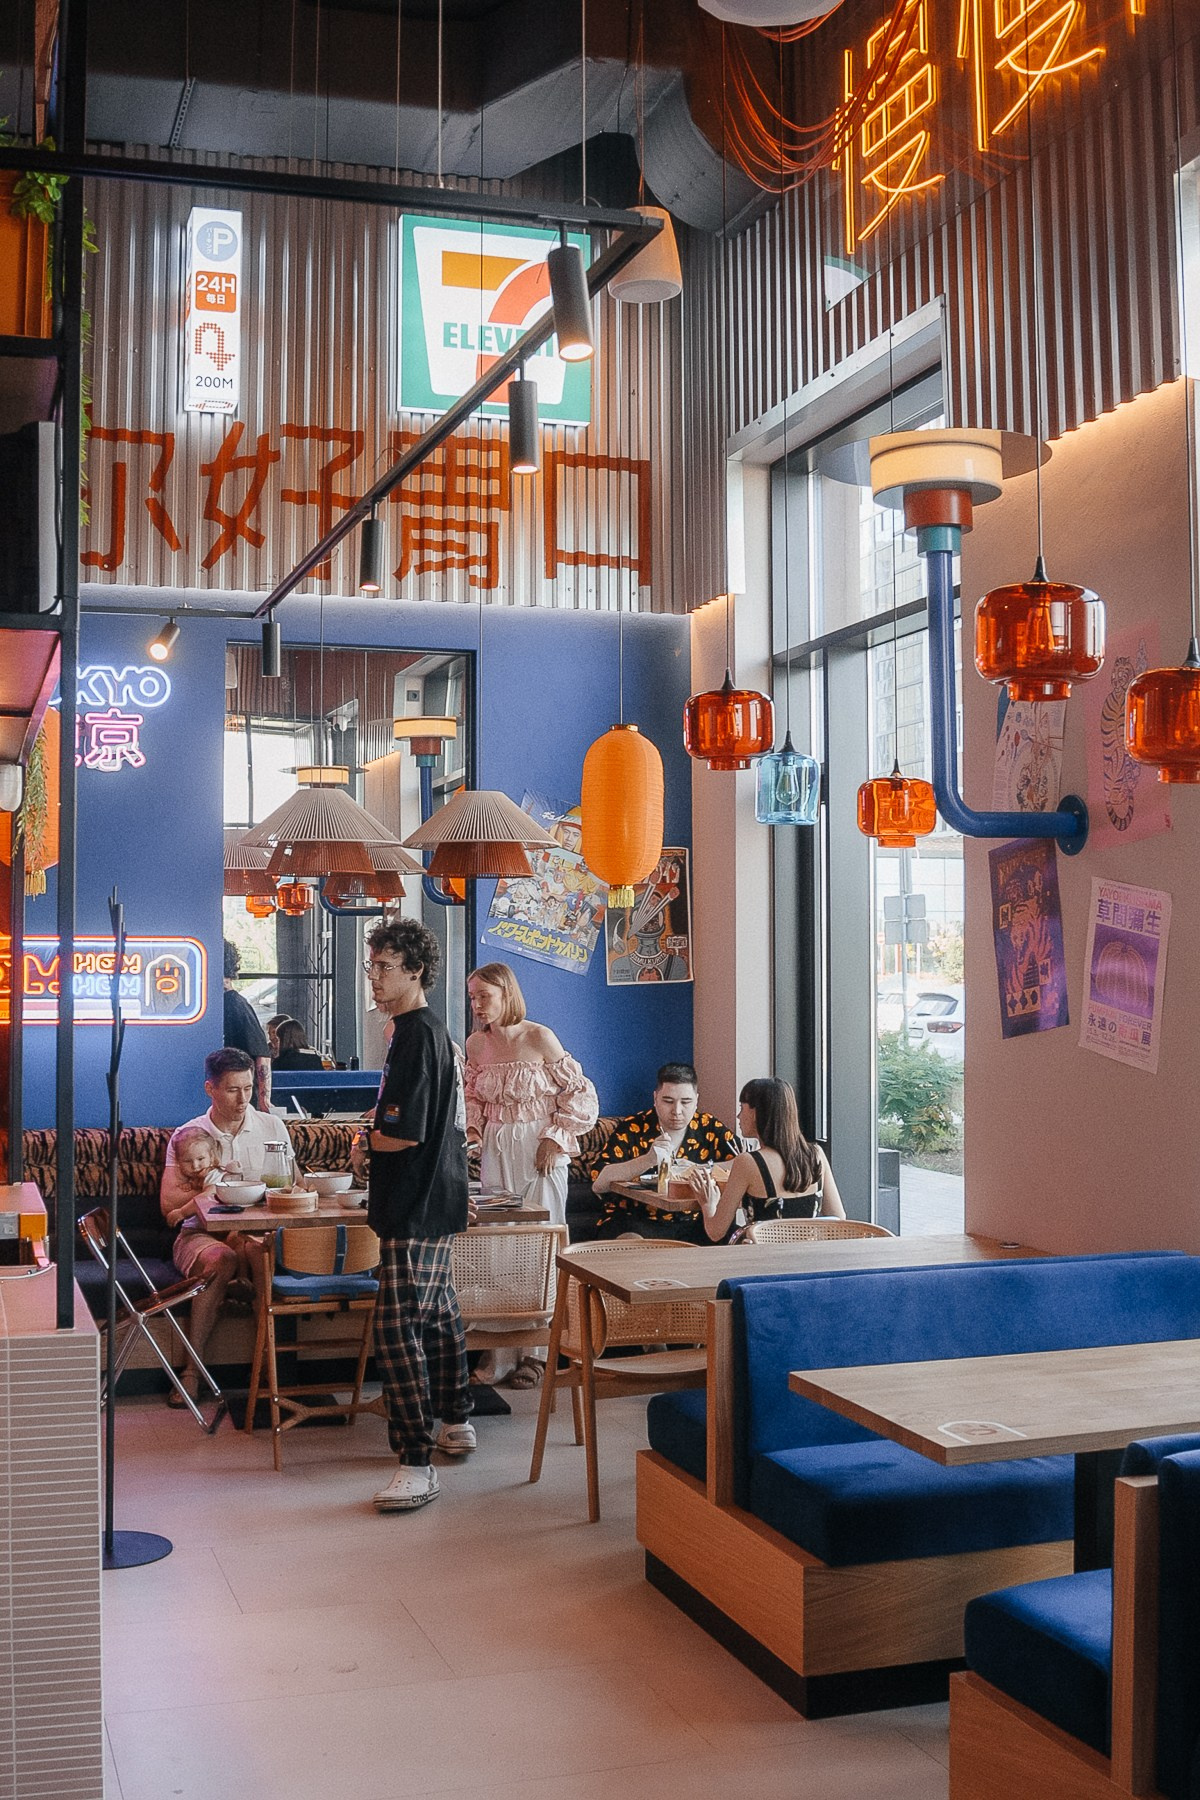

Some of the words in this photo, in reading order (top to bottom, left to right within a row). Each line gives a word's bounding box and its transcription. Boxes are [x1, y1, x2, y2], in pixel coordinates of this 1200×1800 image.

[213, 227, 234, 256] P
[197, 274, 236, 294] 24H
[195, 376, 233, 389] 200M
[48, 665, 171, 707] KYO
[75, 708, 147, 772] 京
